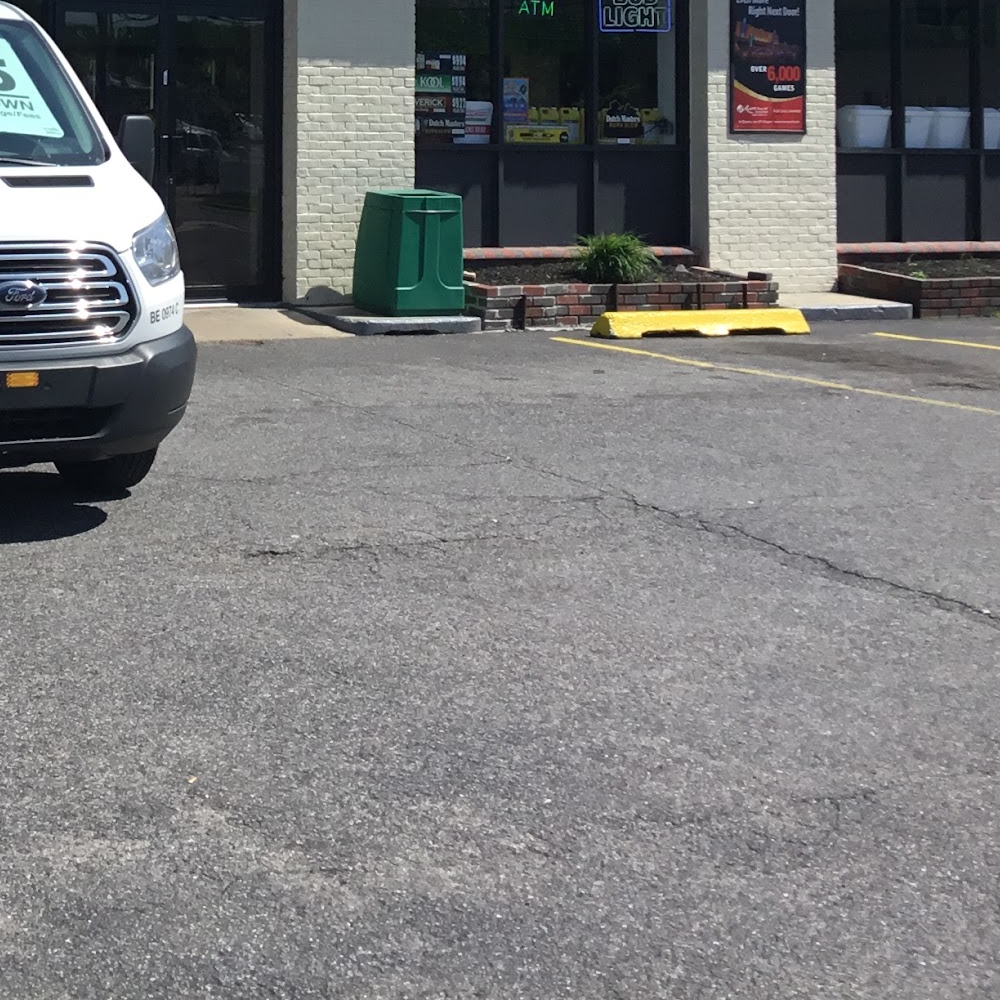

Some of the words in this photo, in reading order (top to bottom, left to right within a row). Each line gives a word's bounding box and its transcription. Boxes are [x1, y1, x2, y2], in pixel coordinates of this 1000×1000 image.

[518, 0, 554, 16] ATM
[748, 6, 766, 17] Right
[767, 7, 782, 16] Next
[603, 6, 666, 27] LIGHT
[750, 65, 767, 73] OVER
[767, 65, 800, 83] 6,000
[420, 76, 444, 88] KOOL
[5, 287, 36, 302] Ford
[150, 310, 160, 324] BE
